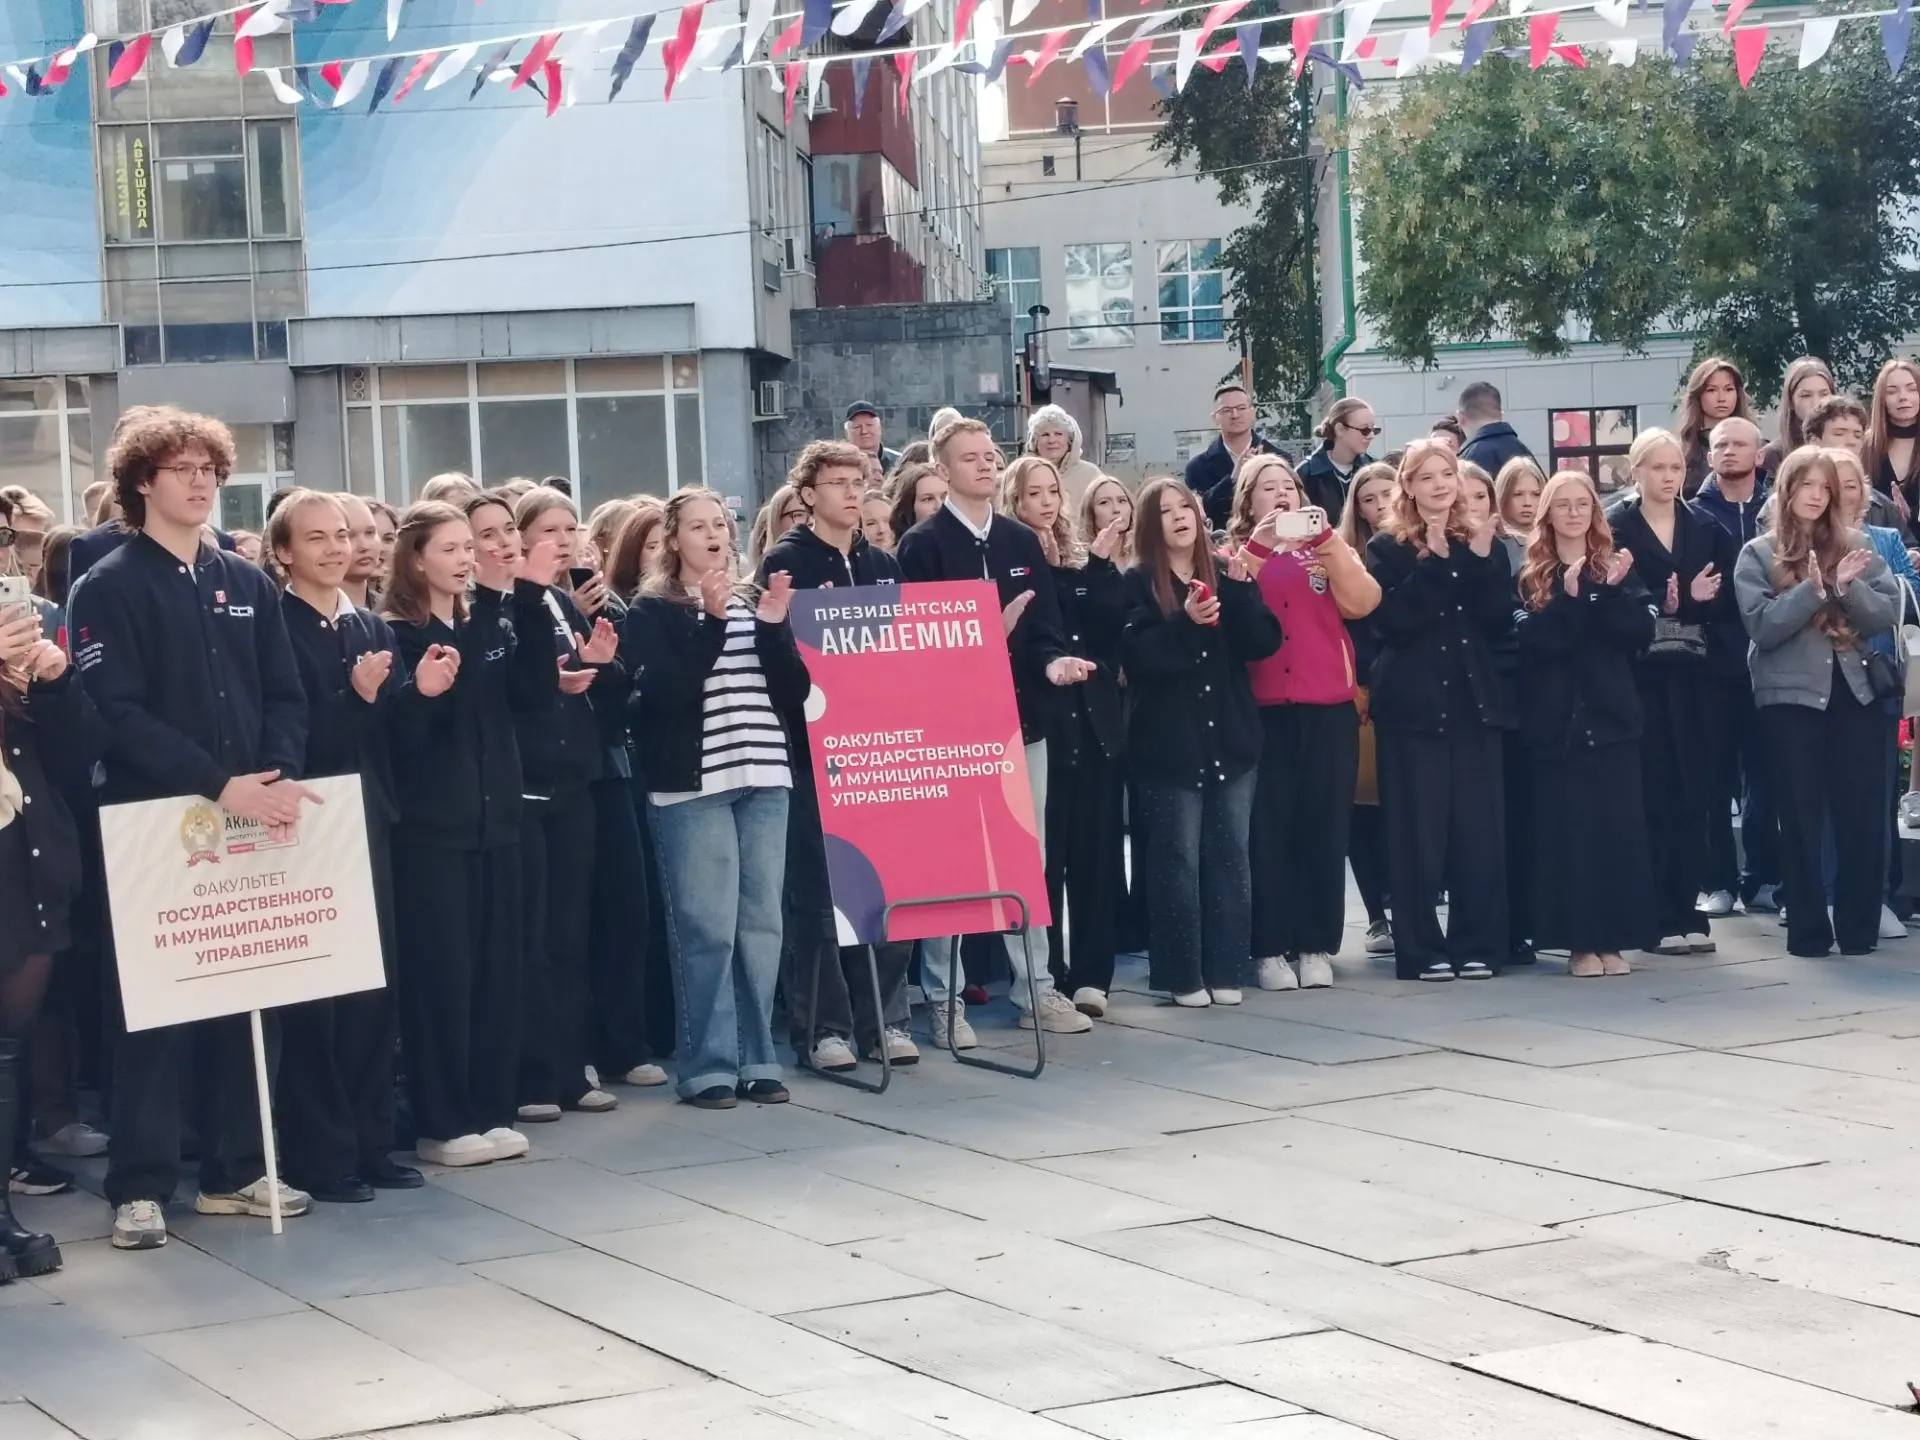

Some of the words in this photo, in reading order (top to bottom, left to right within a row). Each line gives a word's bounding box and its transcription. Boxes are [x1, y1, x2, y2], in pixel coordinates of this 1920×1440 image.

[134, 138, 148, 229] АВТОШКОЛА
[814, 600, 978, 621] ПРЕЗИДЕНТСКАЯ
[821, 619, 983, 656] АКАДЕМИЯ
[823, 729, 924, 749] ФАКУЛЬТЕТ
[826, 742, 1004, 769] ГОСУДАРСТВЕННОГО
[829, 774, 842, 787] И
[846, 760, 1014, 786] МУНИЦИПАЛЬНОГО
[831, 784, 949, 807] УПРАВЛЕНИЯ
[193, 871, 287, 897] ФАКУЛЬТЕТ
[157, 886, 334, 926] ГОСУДАРСТВЕННОГО
[154, 934, 168, 949] И
[171, 907, 338, 947] МУНИЦИПАЛЬНОГО
[195, 934, 309, 965] УПРАВЛЕНИЯ
